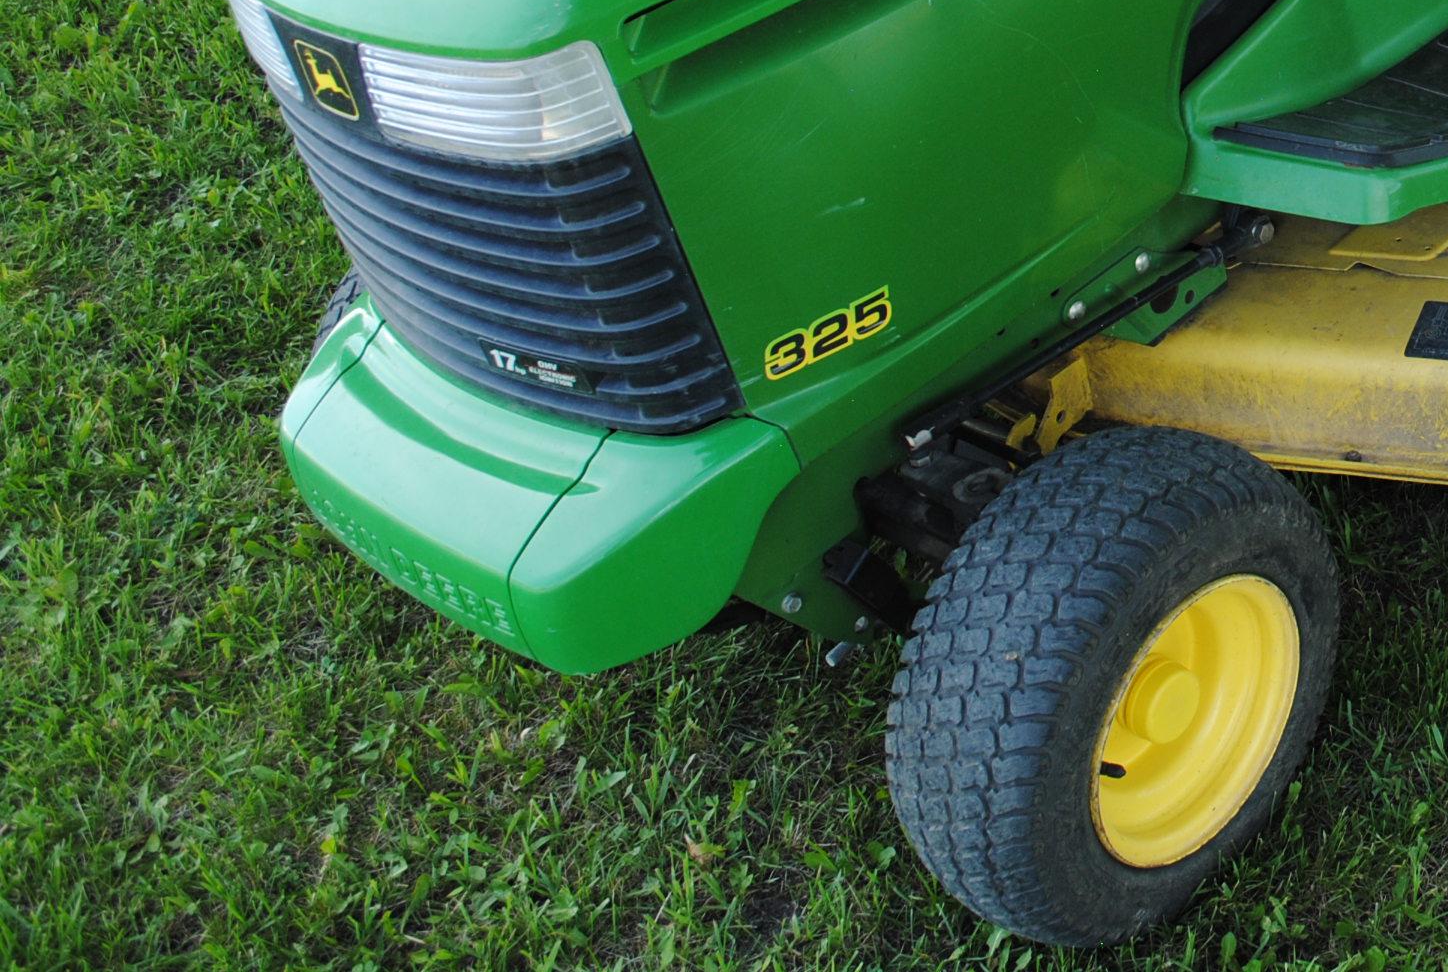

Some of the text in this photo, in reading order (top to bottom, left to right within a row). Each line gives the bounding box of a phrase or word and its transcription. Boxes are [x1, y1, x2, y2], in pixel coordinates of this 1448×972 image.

[490, 349, 516, 371] 17
[766, 285, 891, 379] 325
[389, 546, 517, 637] DEERE
